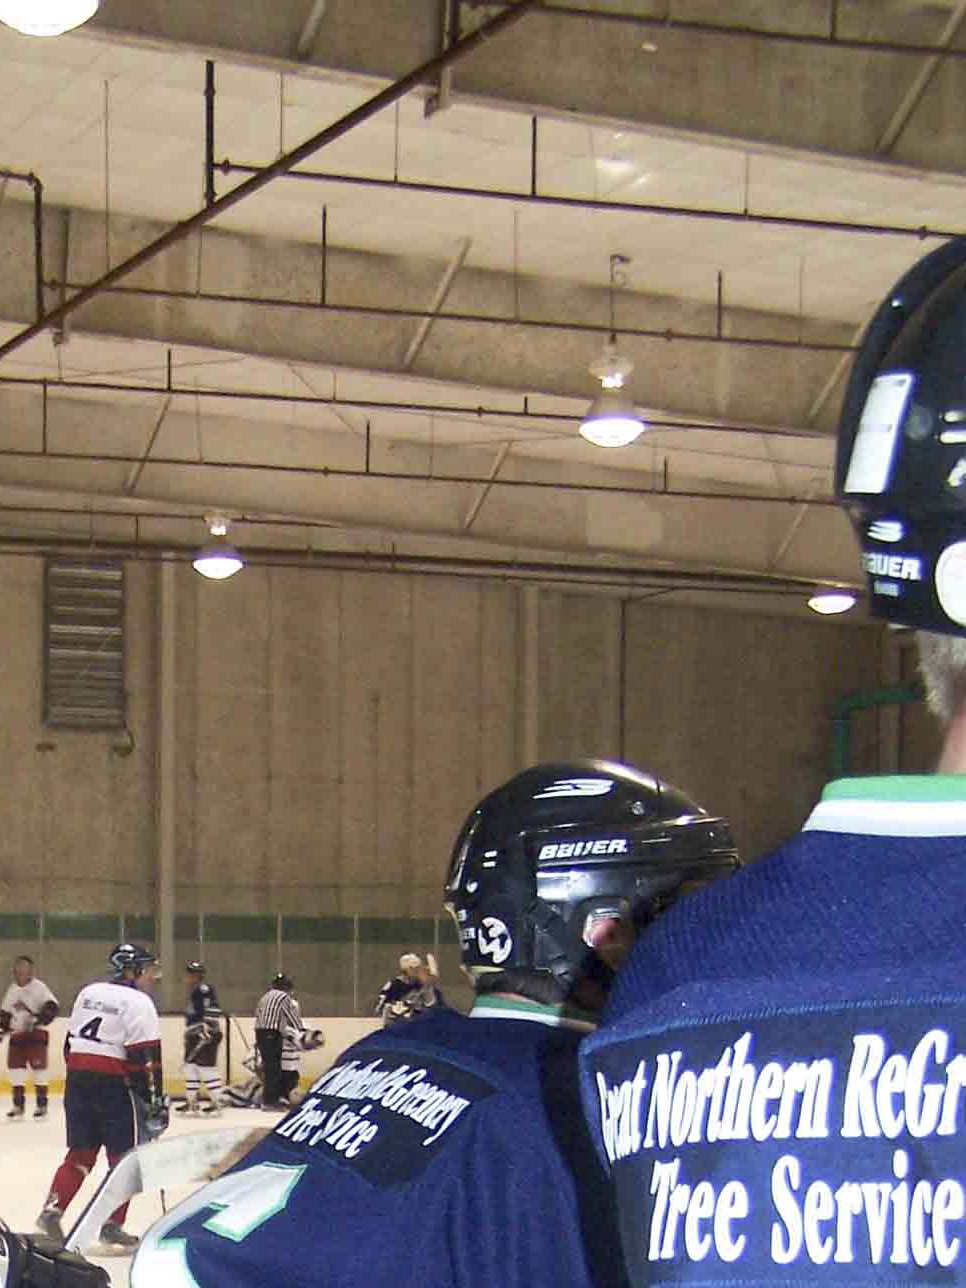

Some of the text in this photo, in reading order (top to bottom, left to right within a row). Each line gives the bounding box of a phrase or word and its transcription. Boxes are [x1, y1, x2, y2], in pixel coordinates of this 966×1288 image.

[538, 839, 628, 860] BAUER
[79, 1016, 104, 1043] 4
[643, 1031, 833, 1150] Northern
[648, 1149, 966, 1267] Tree Service
